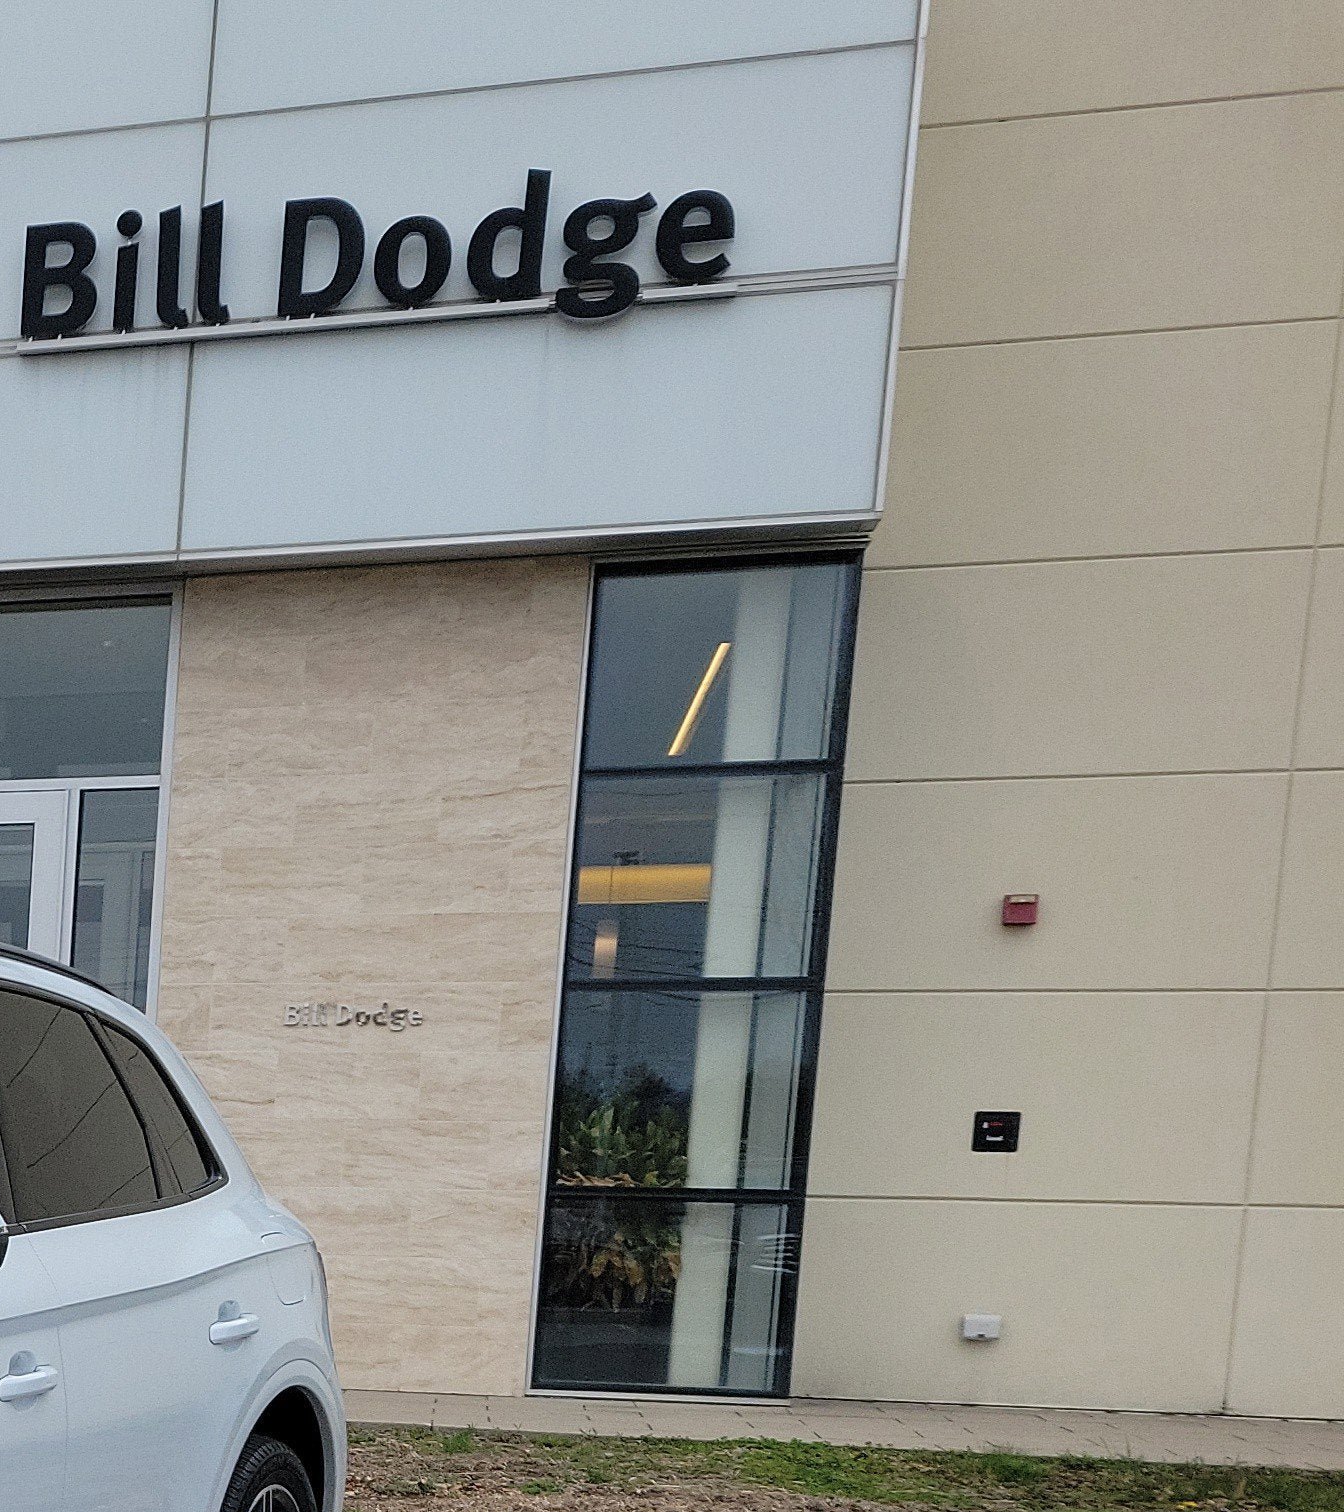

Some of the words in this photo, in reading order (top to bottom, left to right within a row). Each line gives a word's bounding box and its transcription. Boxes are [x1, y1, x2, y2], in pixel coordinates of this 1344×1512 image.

[20, 199, 230, 340] Bill
[277, 168, 736, 322] Dodge
[283, 1003, 328, 1027] Bill
[336, 1002, 424, 1032] Dodge
